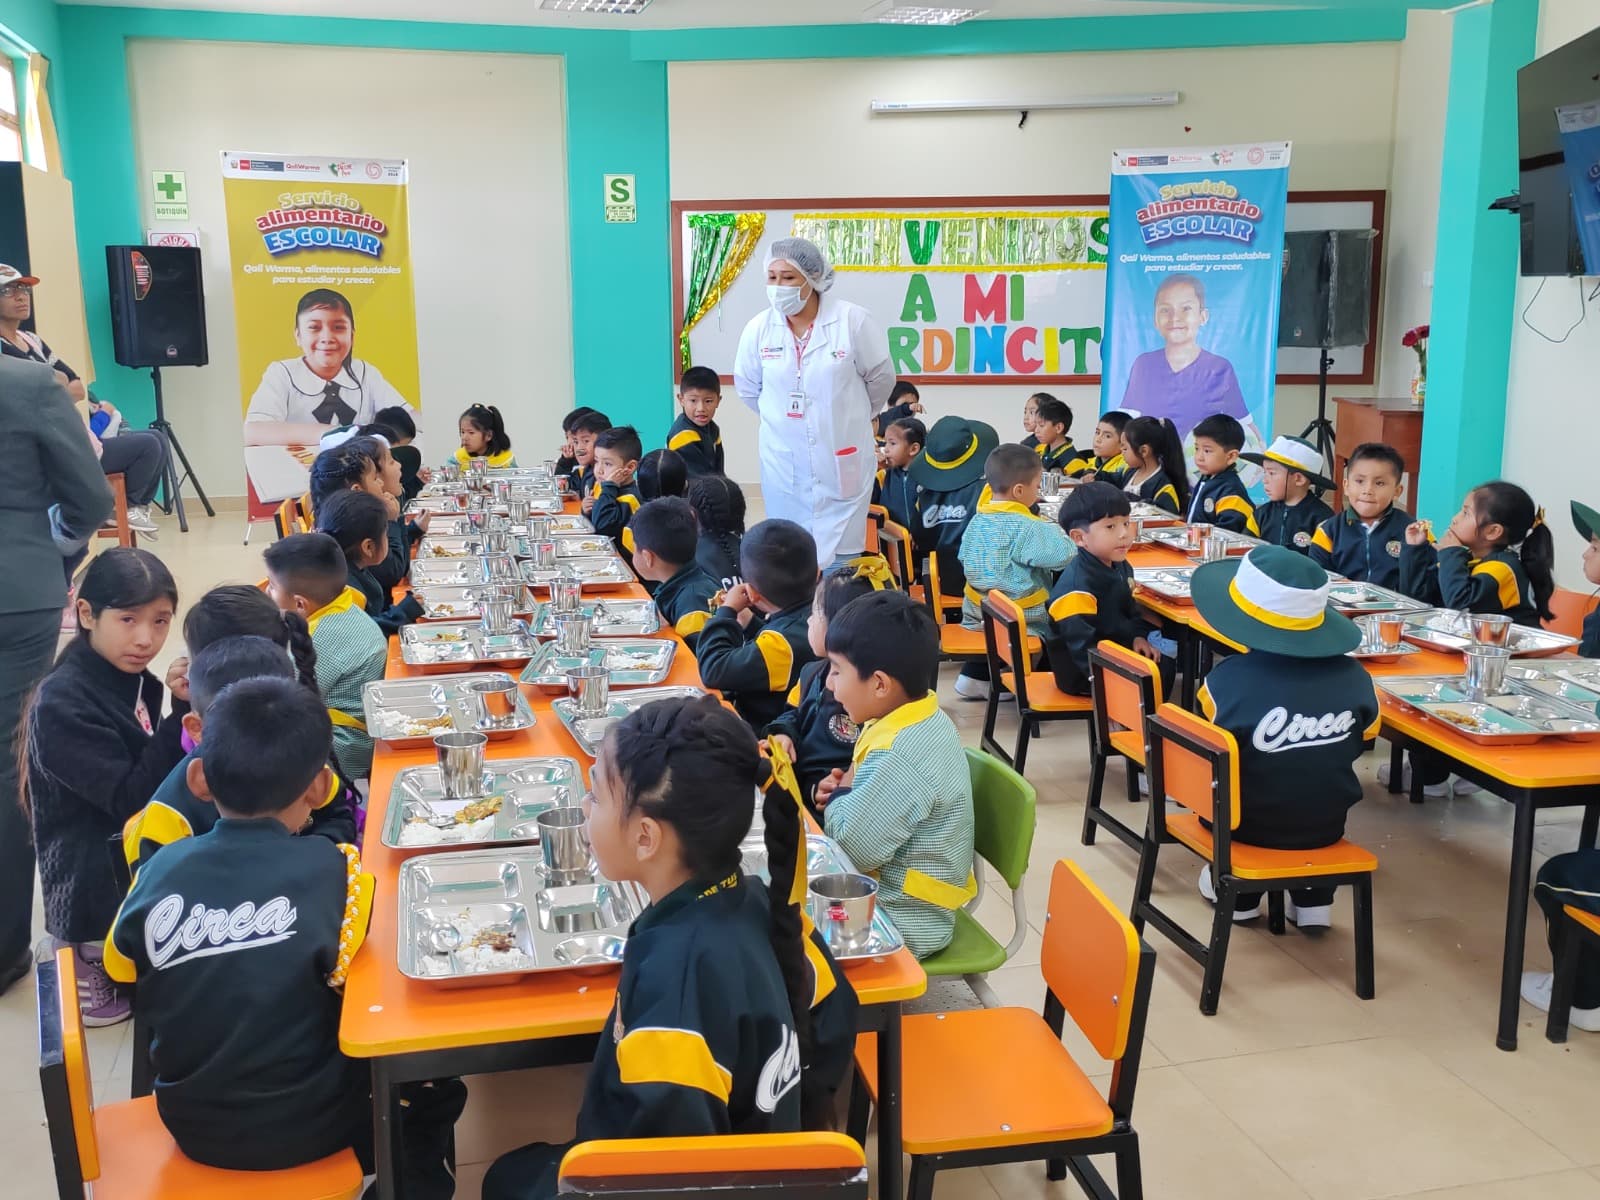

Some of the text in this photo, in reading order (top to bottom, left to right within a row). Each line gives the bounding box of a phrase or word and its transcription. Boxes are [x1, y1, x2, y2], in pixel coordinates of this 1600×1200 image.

[278, 190, 361, 212] Servicio
[610, 178, 630, 203] S
[1158, 179, 1239, 200] Servicio
[256, 208, 386, 233] alimentario
[1136, 197, 1260, 223] alimentario
[263, 228, 380, 256] ESCOLAR
[1140, 216, 1254, 244] ESCOLAR
[243, 264, 401, 274] Qali Warma, alimentos saludables
[1119, 251, 1271, 263] Qali Warma, alimentos saludables
[1144, 263, 1244, 273] para estudiar y crecer.
[272, 275, 375, 285] para estudiar y crecer.
[899, 273, 1025, 324] A MI
[887, 325, 1104, 374] RDINCIT
[1252, 706, 1356, 753] Circa
[144, 893, 298, 970] Circa
